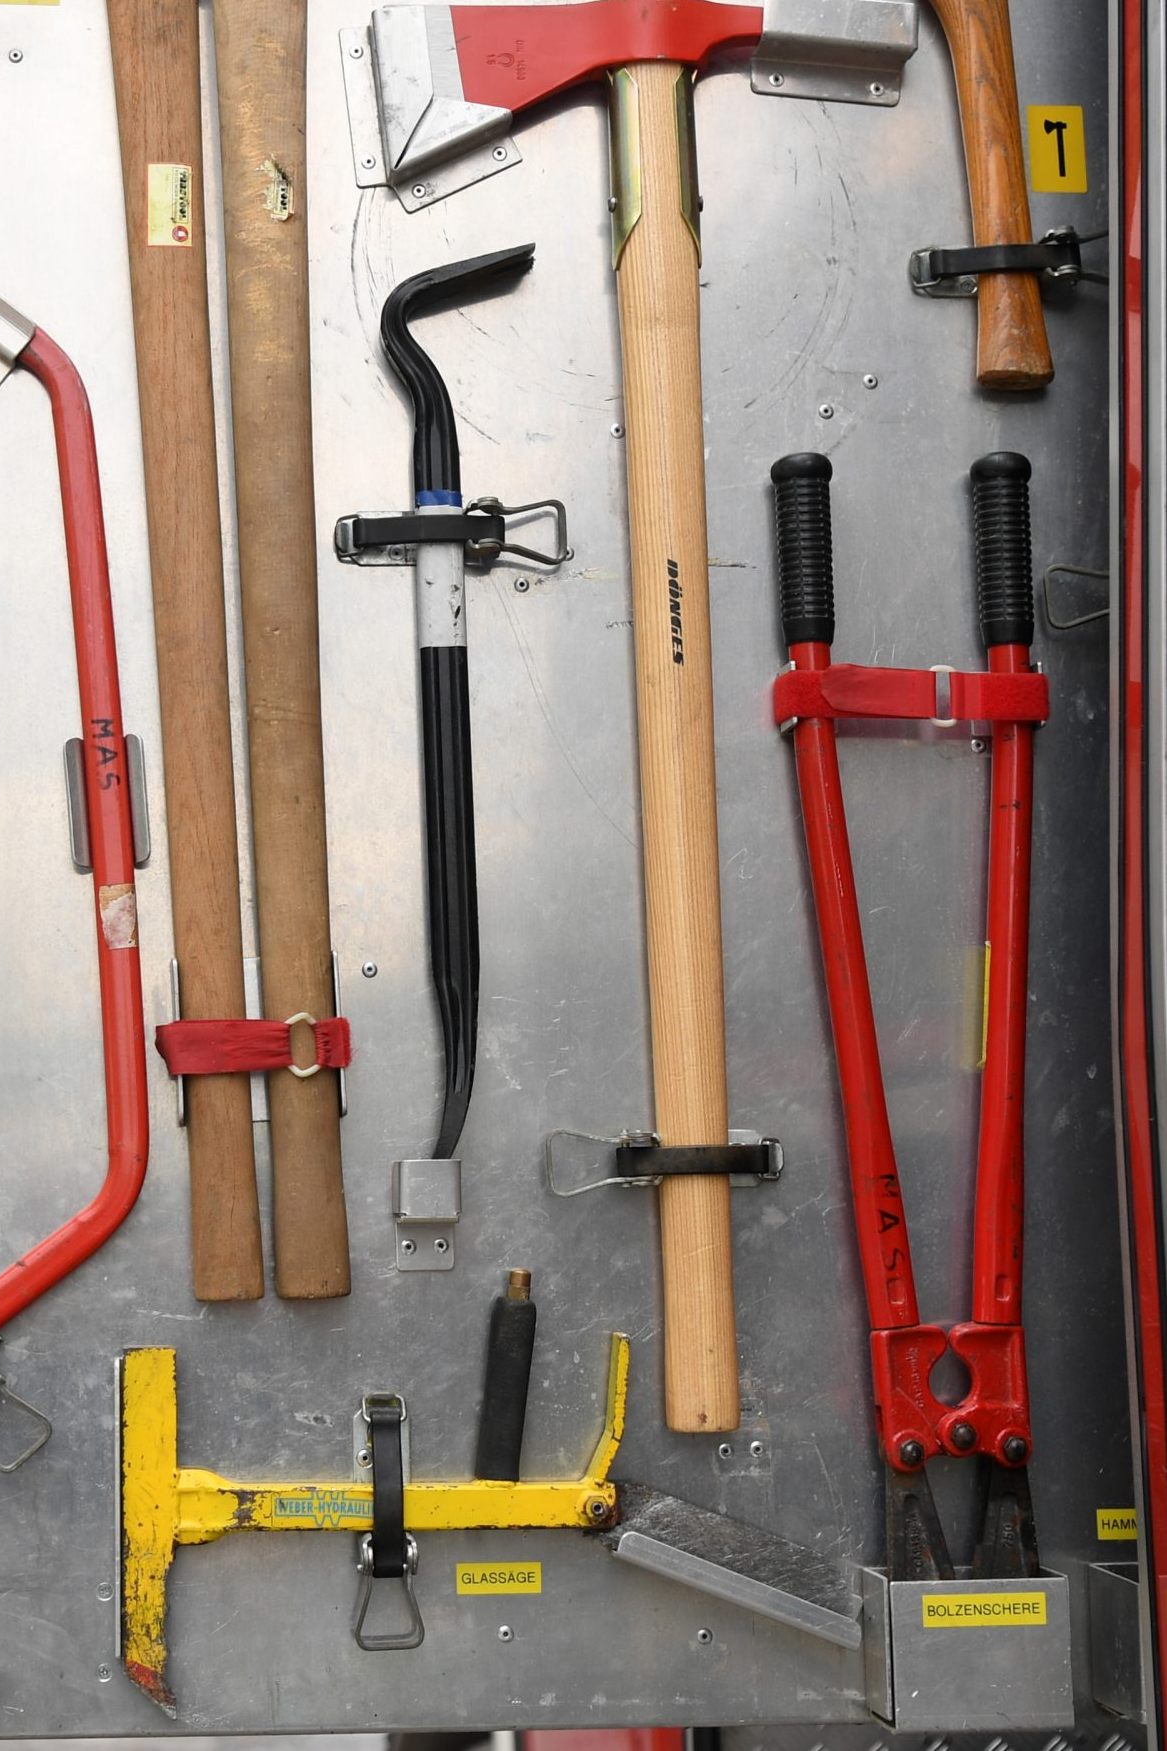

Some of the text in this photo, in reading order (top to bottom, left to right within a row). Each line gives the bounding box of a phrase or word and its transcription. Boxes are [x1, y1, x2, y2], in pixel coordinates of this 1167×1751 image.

[667, 558, 684, 667] DÖNGES
[91, 718, 121, 791] MAS
[461, 1570, 536, 1585] GLASSÄGE
[927, 1602, 1040, 1617] BOLZENSCHERE
